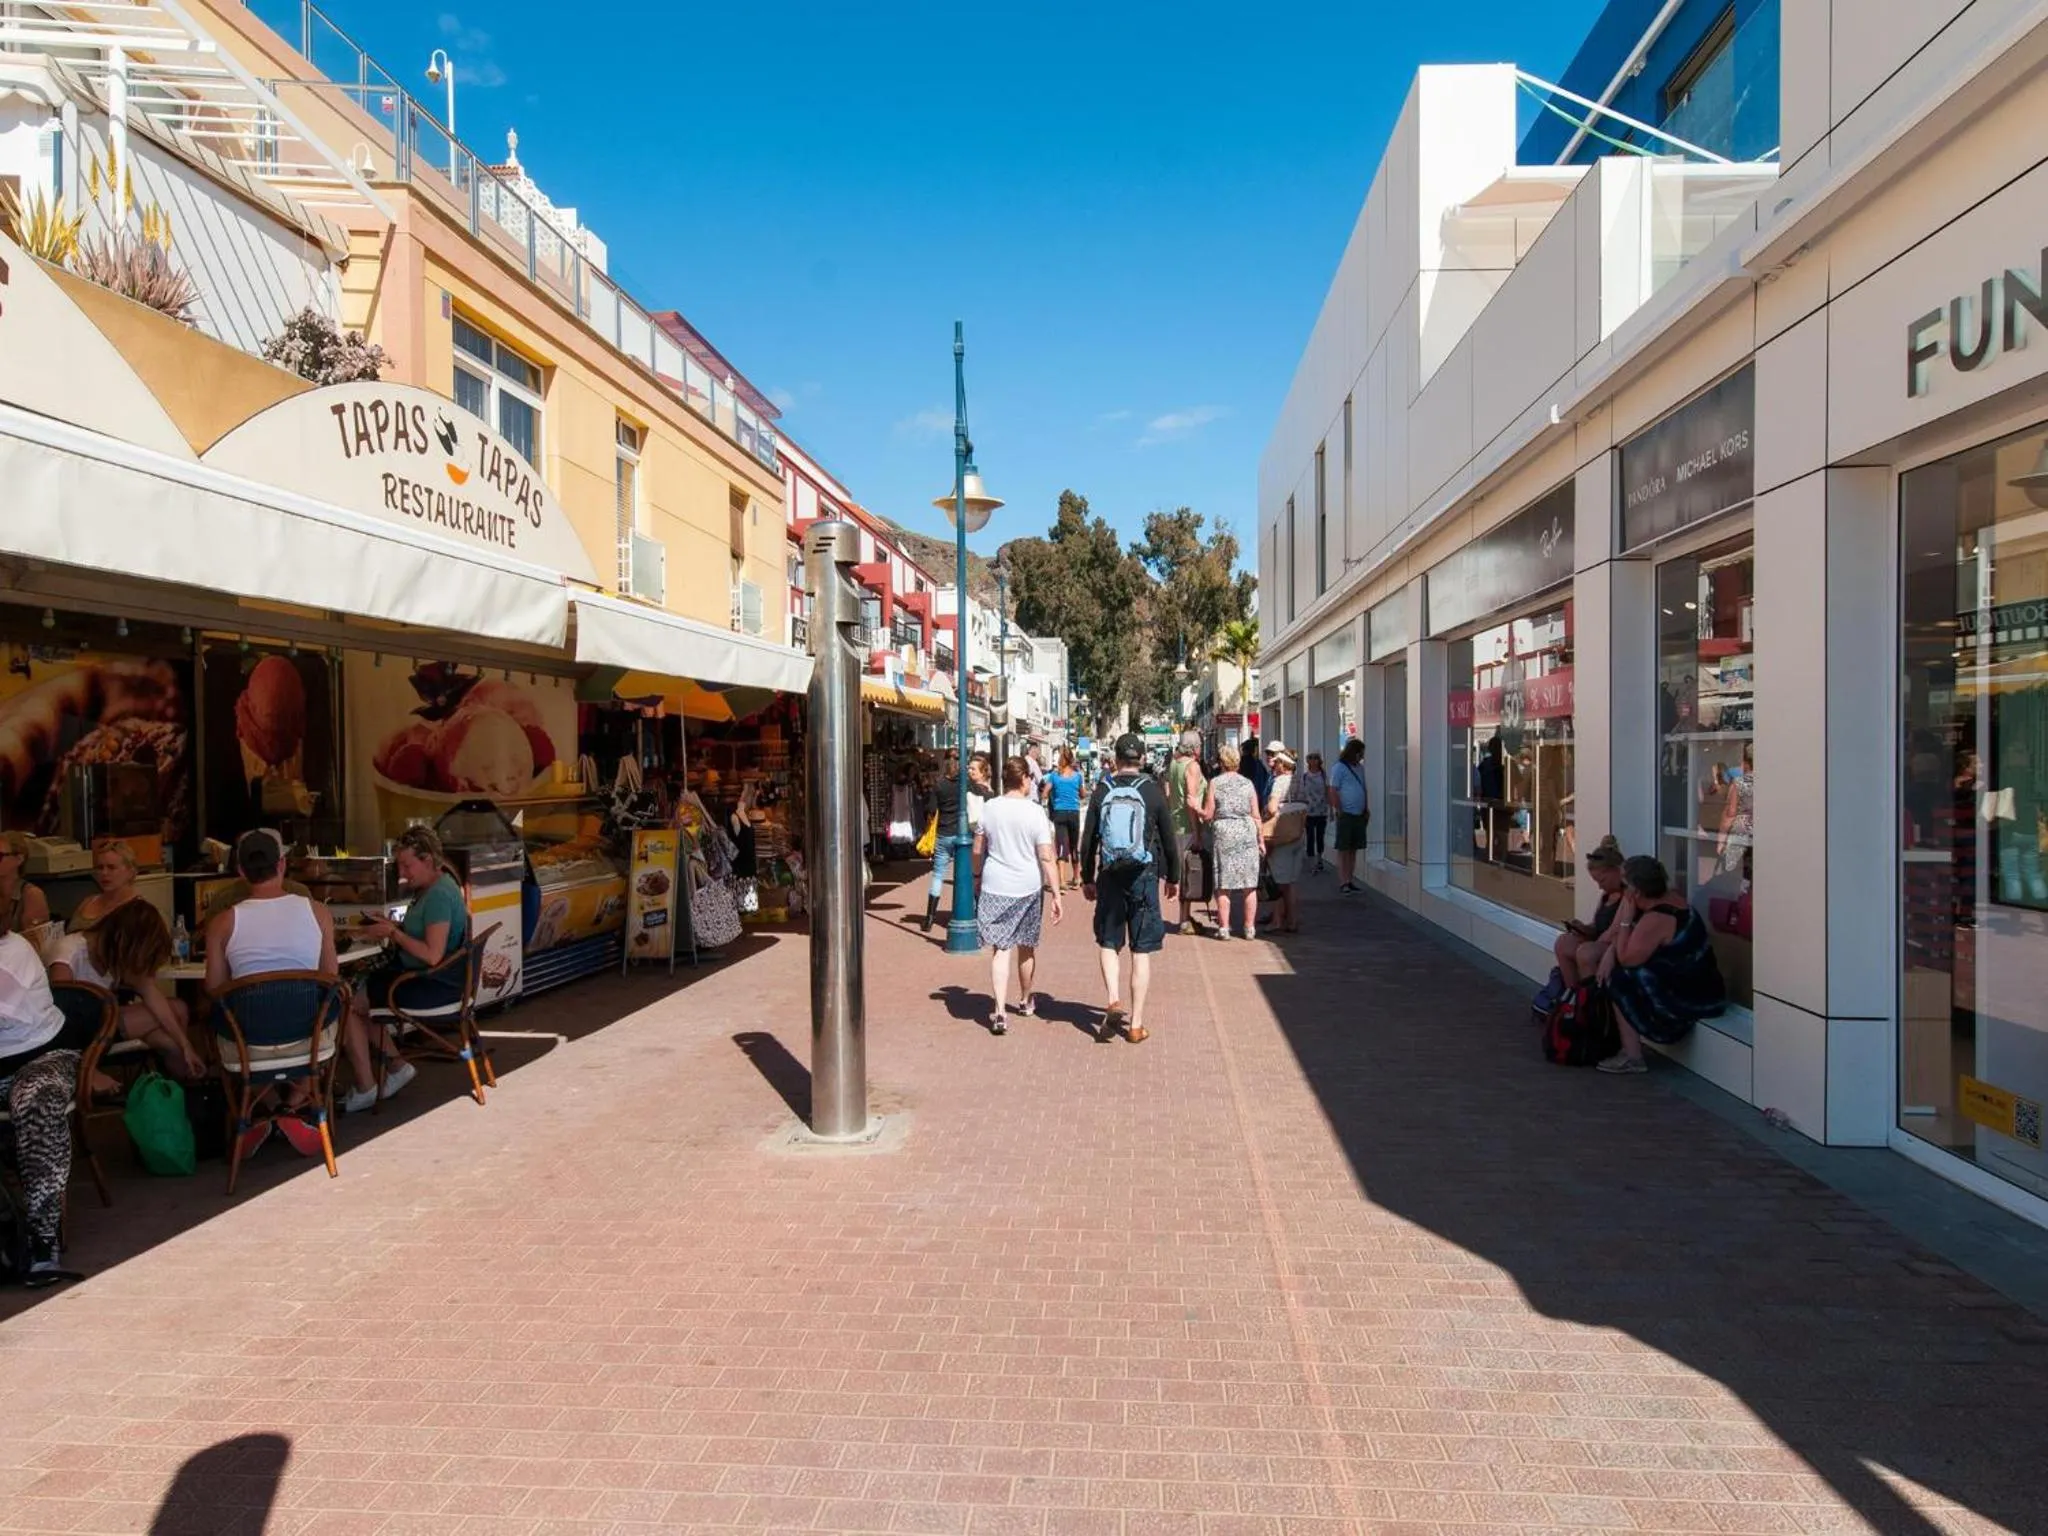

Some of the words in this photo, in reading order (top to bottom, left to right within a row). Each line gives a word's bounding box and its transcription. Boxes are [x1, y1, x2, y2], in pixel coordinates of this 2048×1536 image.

[330, 399, 429, 459] TAPAS
[477, 431, 543, 528] TAPAS
[1676, 448, 1718, 483] MICHAEL
[1719, 429, 1749, 461] KORS
[381, 471, 516, 549] RESTAURANTE
[1627, 476, 1666, 509] PANDORA
